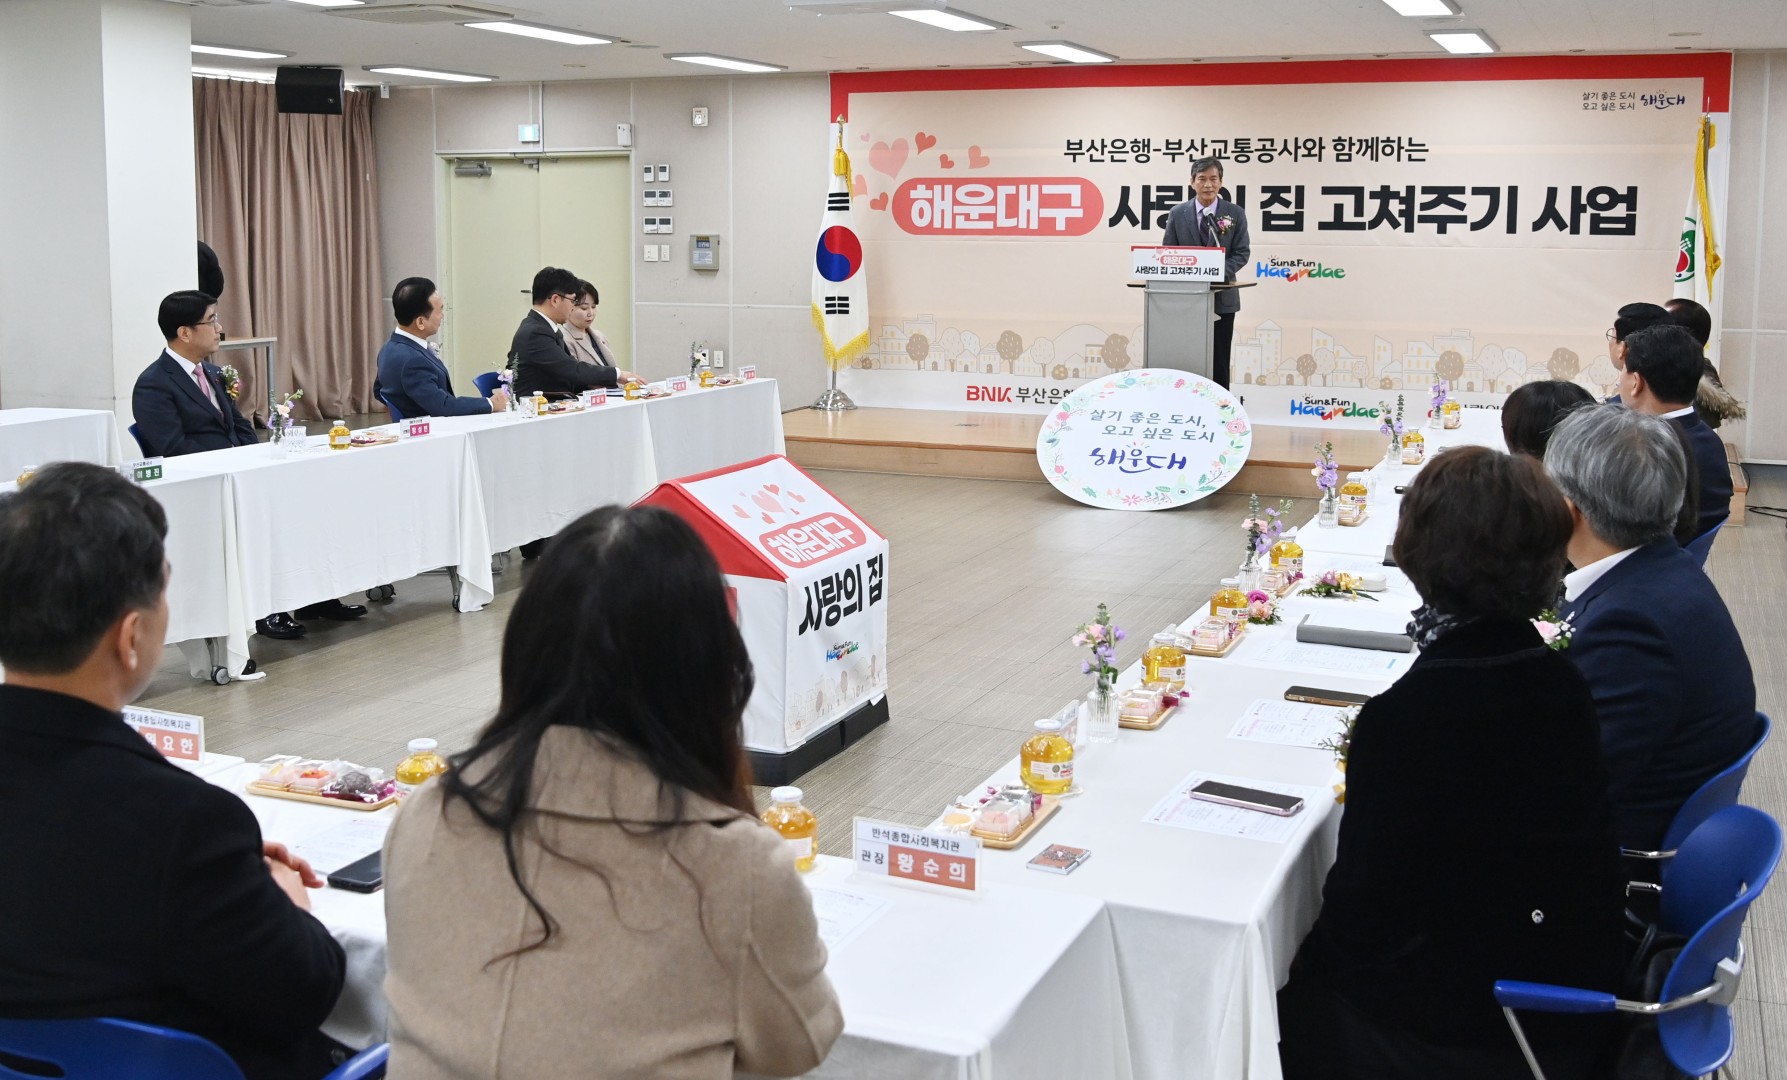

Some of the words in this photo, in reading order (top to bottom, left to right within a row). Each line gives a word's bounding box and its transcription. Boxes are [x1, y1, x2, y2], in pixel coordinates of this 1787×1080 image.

[1582, 92, 1598, 100] 살기
[1601, 92, 1616, 100] 좋은
[1619, 92, 1635, 100] 도시
[1640, 93, 1685, 110] 해운대
[1601, 102, 1616, 111] 싶은
[1619, 102, 1635, 110] 도시
[1063, 137, 1325, 163] 부산은행-부산교통공사와
[1333, 136, 1429, 162] 함께하는
[909, 184, 1083, 230] 해운대구
[1260, 185, 1305, 232] 집
[1318, 185, 1518, 235] 고쳐주기
[1532, 186, 1638, 236] 사업
[1163, 256, 1194, 265] 해운대구
[1271, 258, 1315, 267] Sun&Fun
[1135, 266, 1158, 275] 사랑의
[1160, 266, 1168, 275] 집
[1170, 267, 1201, 276] 고쳐주기
[1203, 267, 1219, 276] 사업
[1256, 261, 1346, 282] Haeundae
[966, 385, 1012, 402] BNK
[1304, 396, 1350, 406] Sun&Fun
[1090, 408, 1122, 422] 살기
[1130, 411, 1161, 425] 좋은
[1168, 414, 1206, 429] 도시,
[1290, 399, 1380, 421] Haeundae
[1101, 425, 1133, 437] 오고
[1143, 427, 1174, 440] 싶은
[1181, 429, 1215, 443] 도시
[1089, 447, 1187, 473] 해운대
[767, 516, 857, 563] 해운대구
[799, 563, 863, 636] 사랑의
[866, 553, 883, 607] 집
[872, 827, 960, 853] 반석종합사회복지관
[861, 849, 884, 865] 관장
